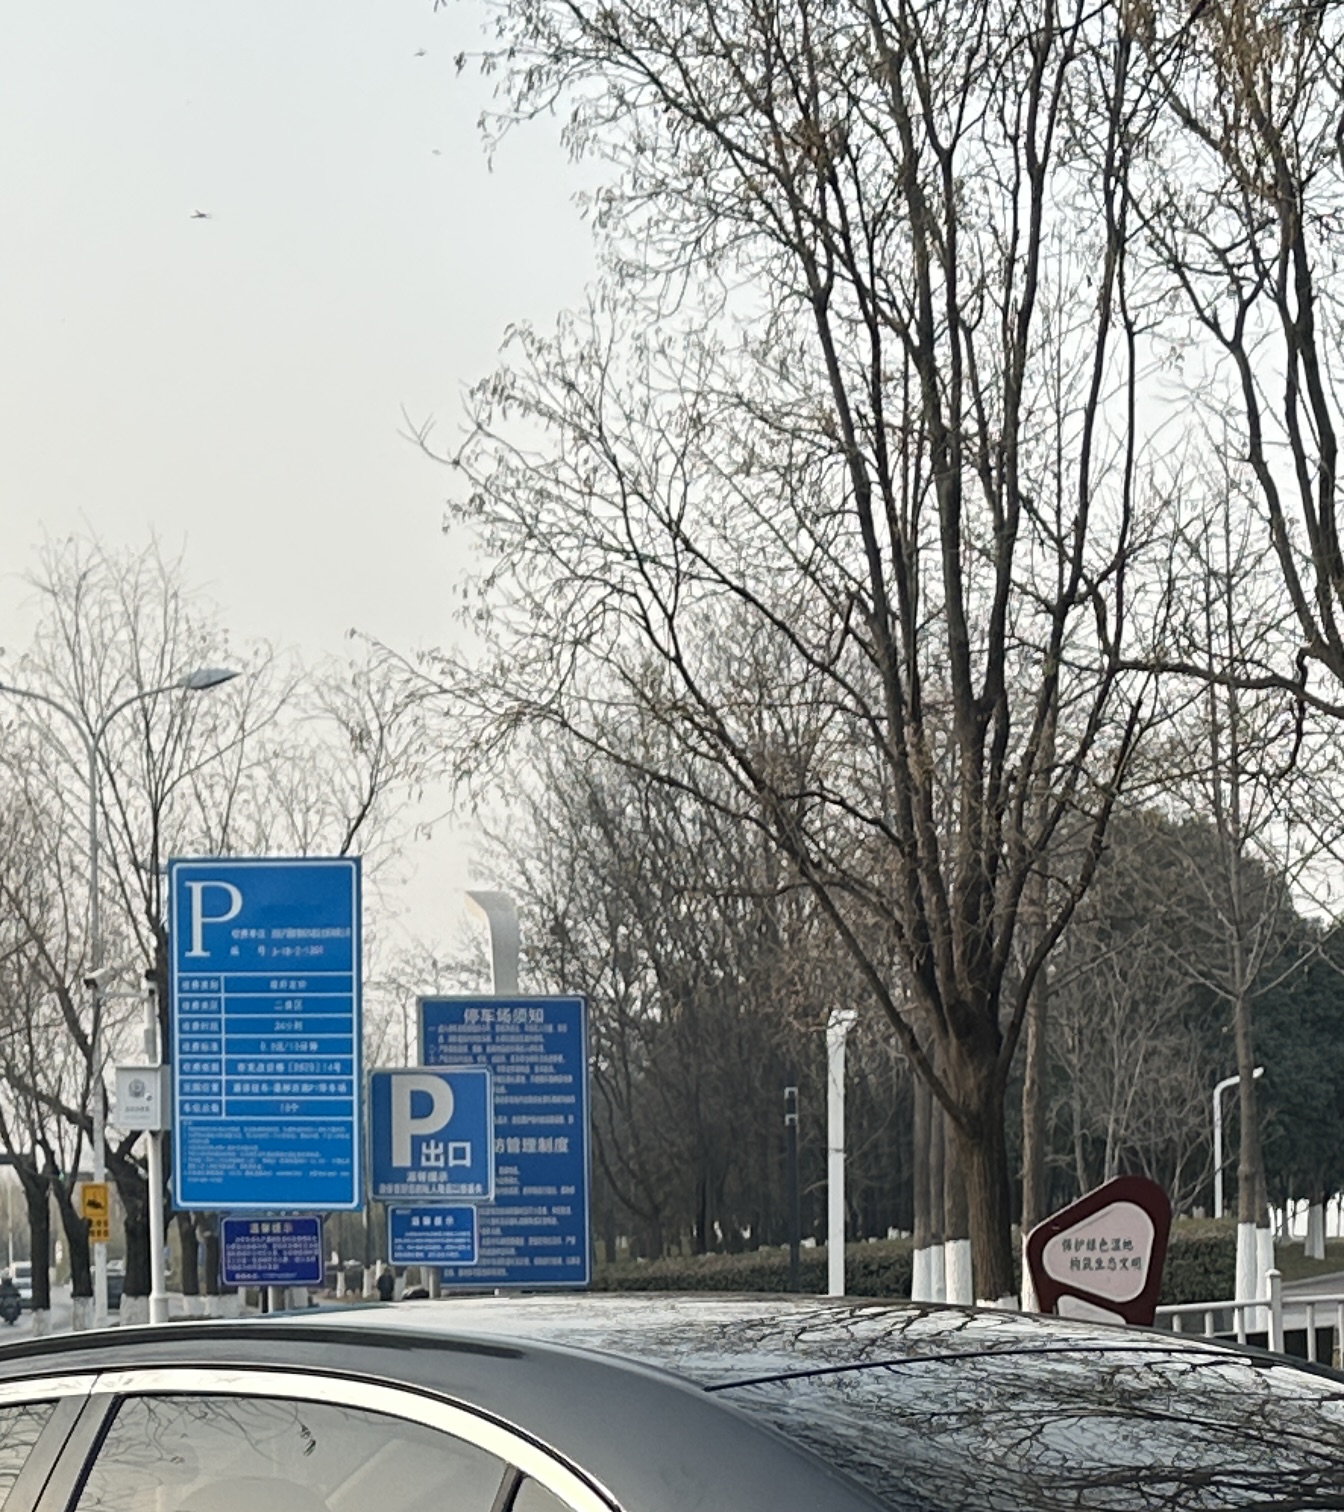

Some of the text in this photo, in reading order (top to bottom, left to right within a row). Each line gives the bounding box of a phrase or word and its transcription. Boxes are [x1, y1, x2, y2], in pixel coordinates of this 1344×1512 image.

[184, 880, 243, 957] P
[464, 1008, 544, 1024] 停车场须知
[391, 1074, 454, 1168] P
[420, 1139, 472, 1168] 出口
[1061, 1237, 1134, 1253] 保护绿色湿地
